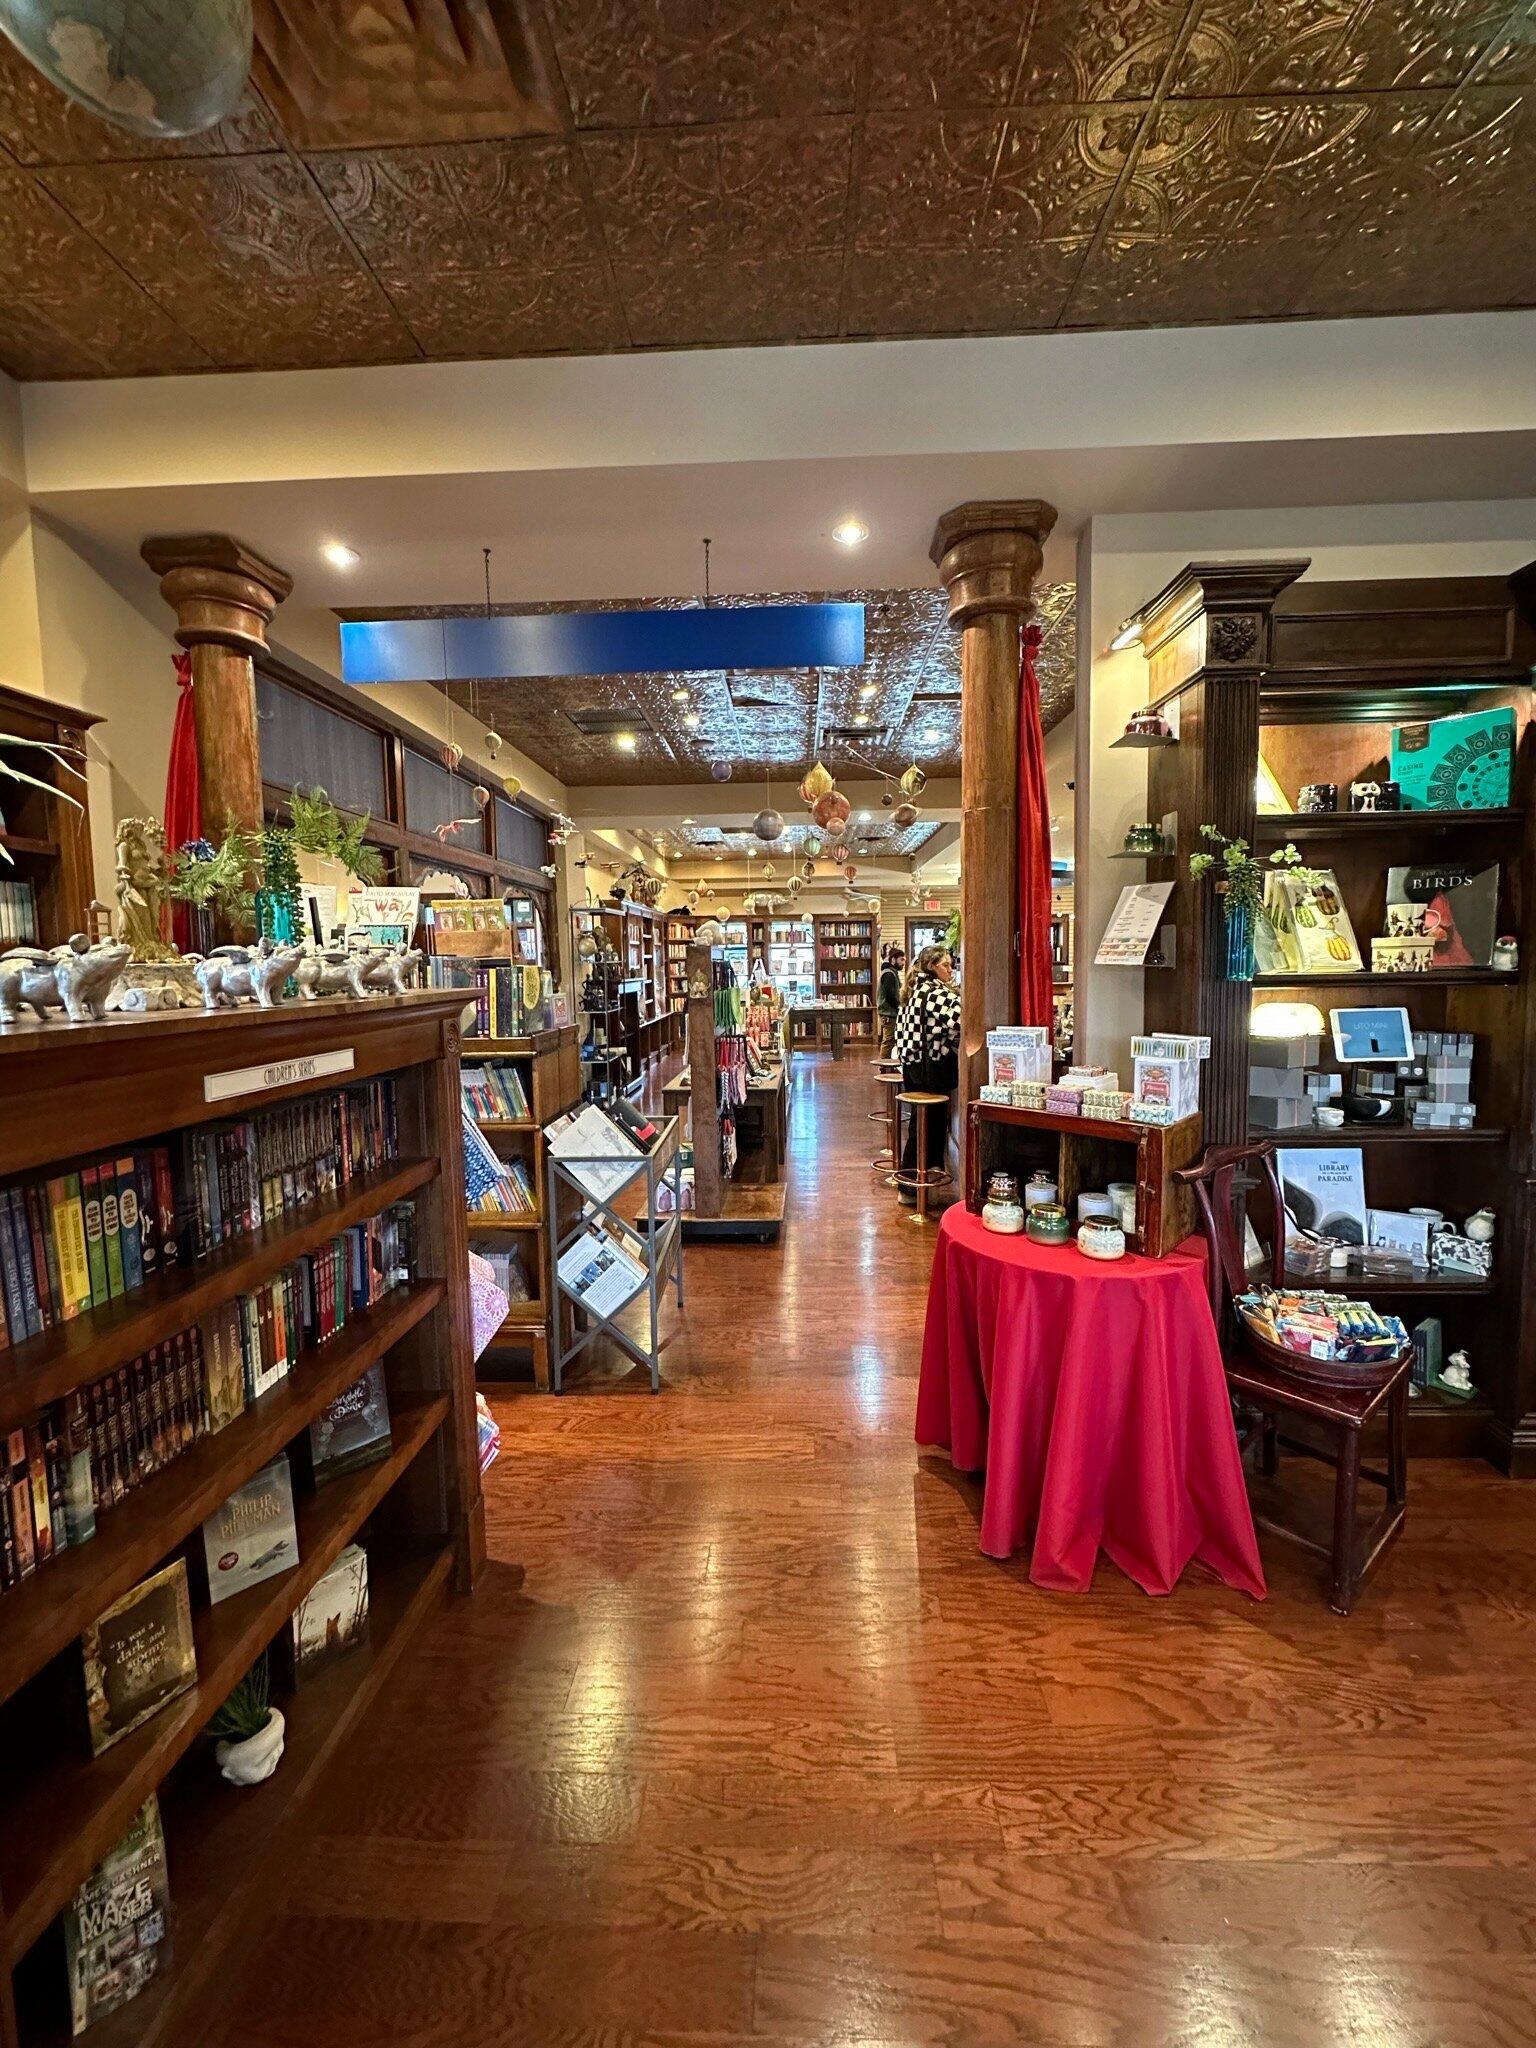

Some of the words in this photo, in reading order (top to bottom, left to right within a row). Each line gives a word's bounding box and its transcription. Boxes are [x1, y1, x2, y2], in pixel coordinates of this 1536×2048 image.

[1413, 875, 1473, 890] BIRDS
[263, 1064, 297, 1086] CHILDREN'S
[298, 1058, 316, 1078] SERIES
[232, 1494, 272, 1520] PHILIP
[117, 1640, 145, 1664] dark
[149, 1626, 166, 1643] and
[129, 1627, 146, 1642] was
[111, 1853, 161, 1888] DASHNER
[79, 1876, 151, 1926] MAZE
[80, 1889, 154, 1944] RUNNER
